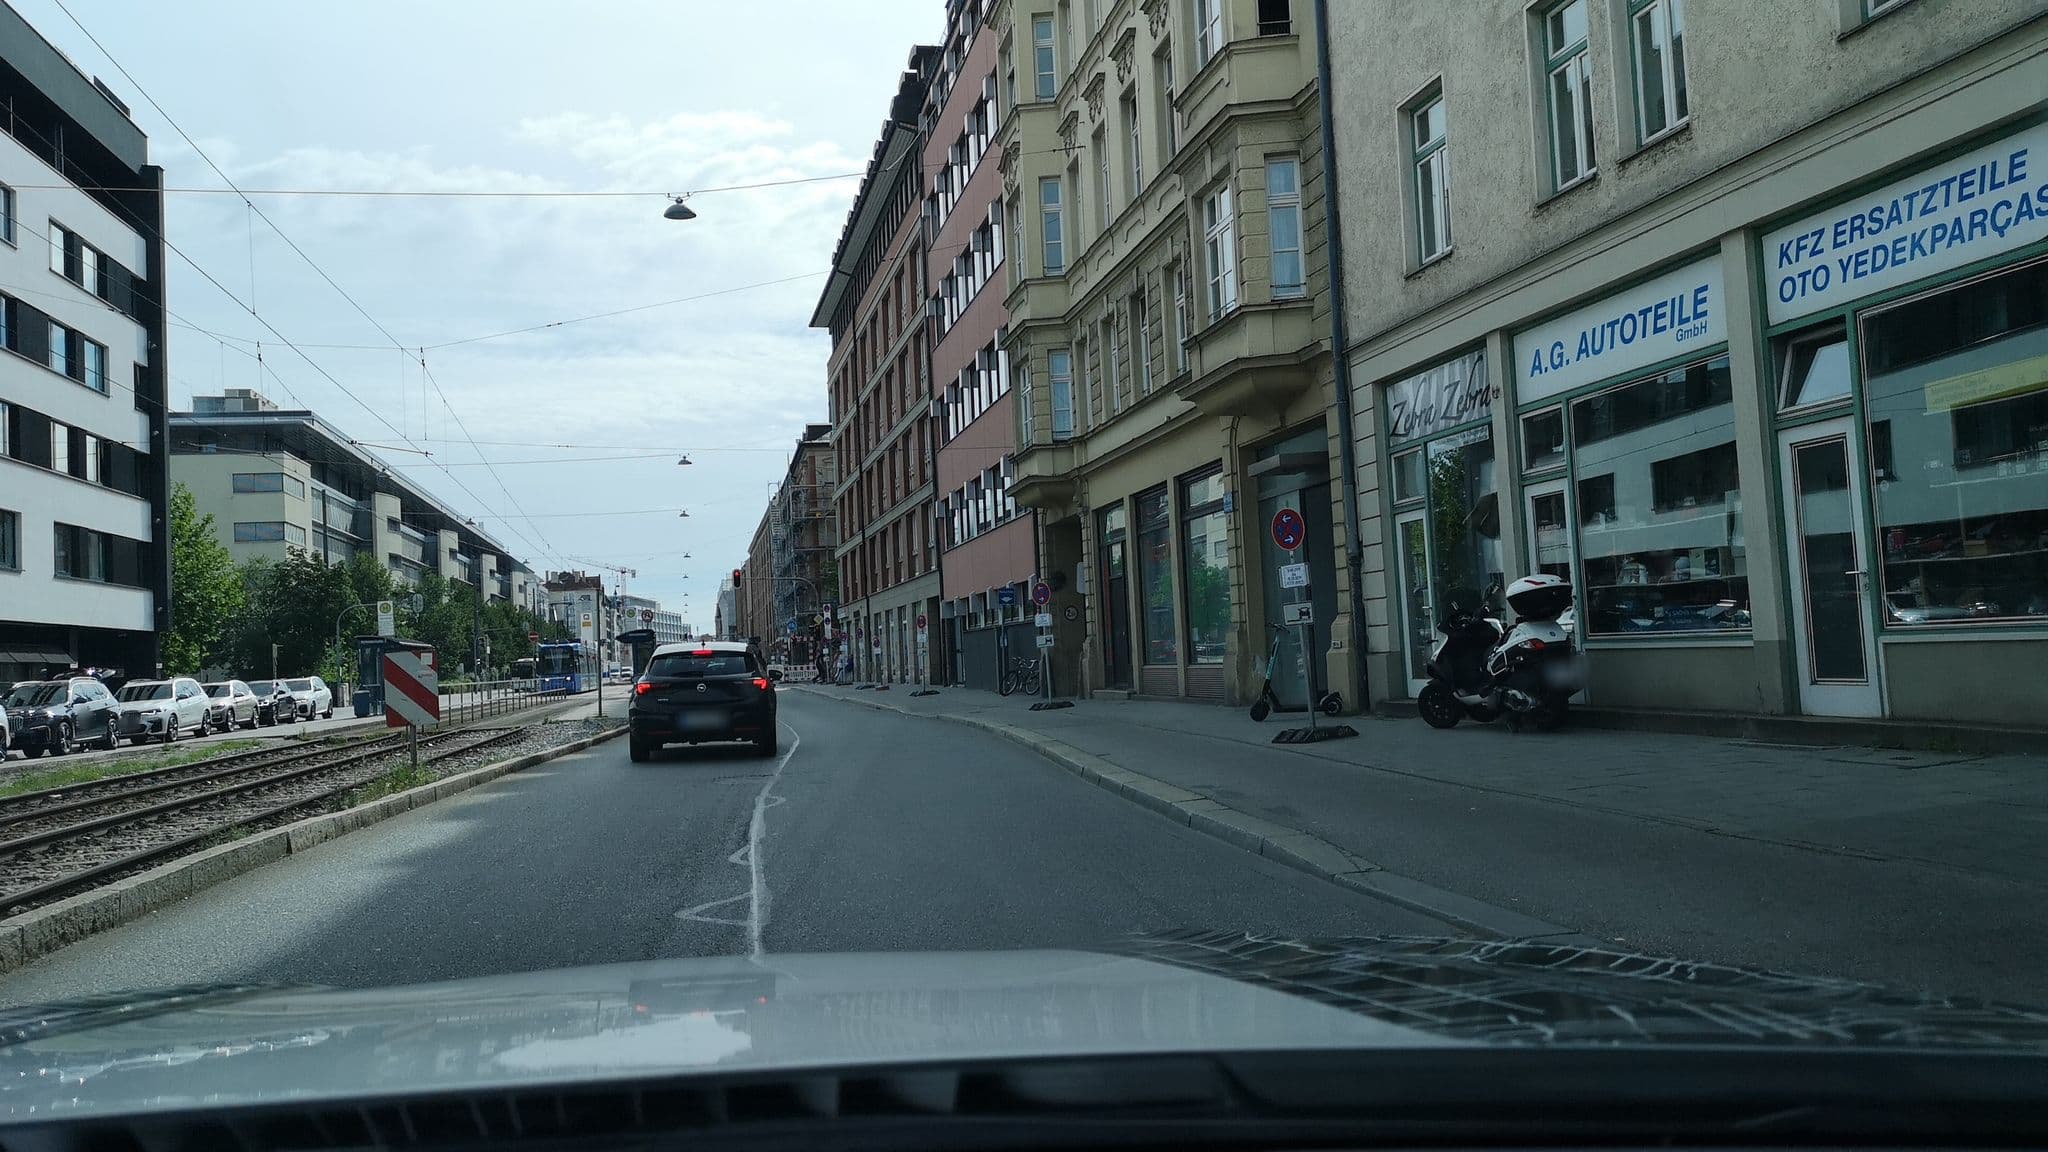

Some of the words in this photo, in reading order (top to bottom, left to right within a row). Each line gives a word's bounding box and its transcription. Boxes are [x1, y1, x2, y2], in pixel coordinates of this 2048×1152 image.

[1778, 227, 1825, 269] KFZ
[1832, 148, 2028, 250] ERSATZTEILE
[1779, 264, 1830, 303] OTO
[1530, 340, 1570, 377] A.G.
[1576, 284, 1709, 362] AUTOTEILE
[1676, 320, 1708, 342] GmbH
[1389, 377, 1437, 437] Zebra
[1440, 354, 1491, 420] Zebra
